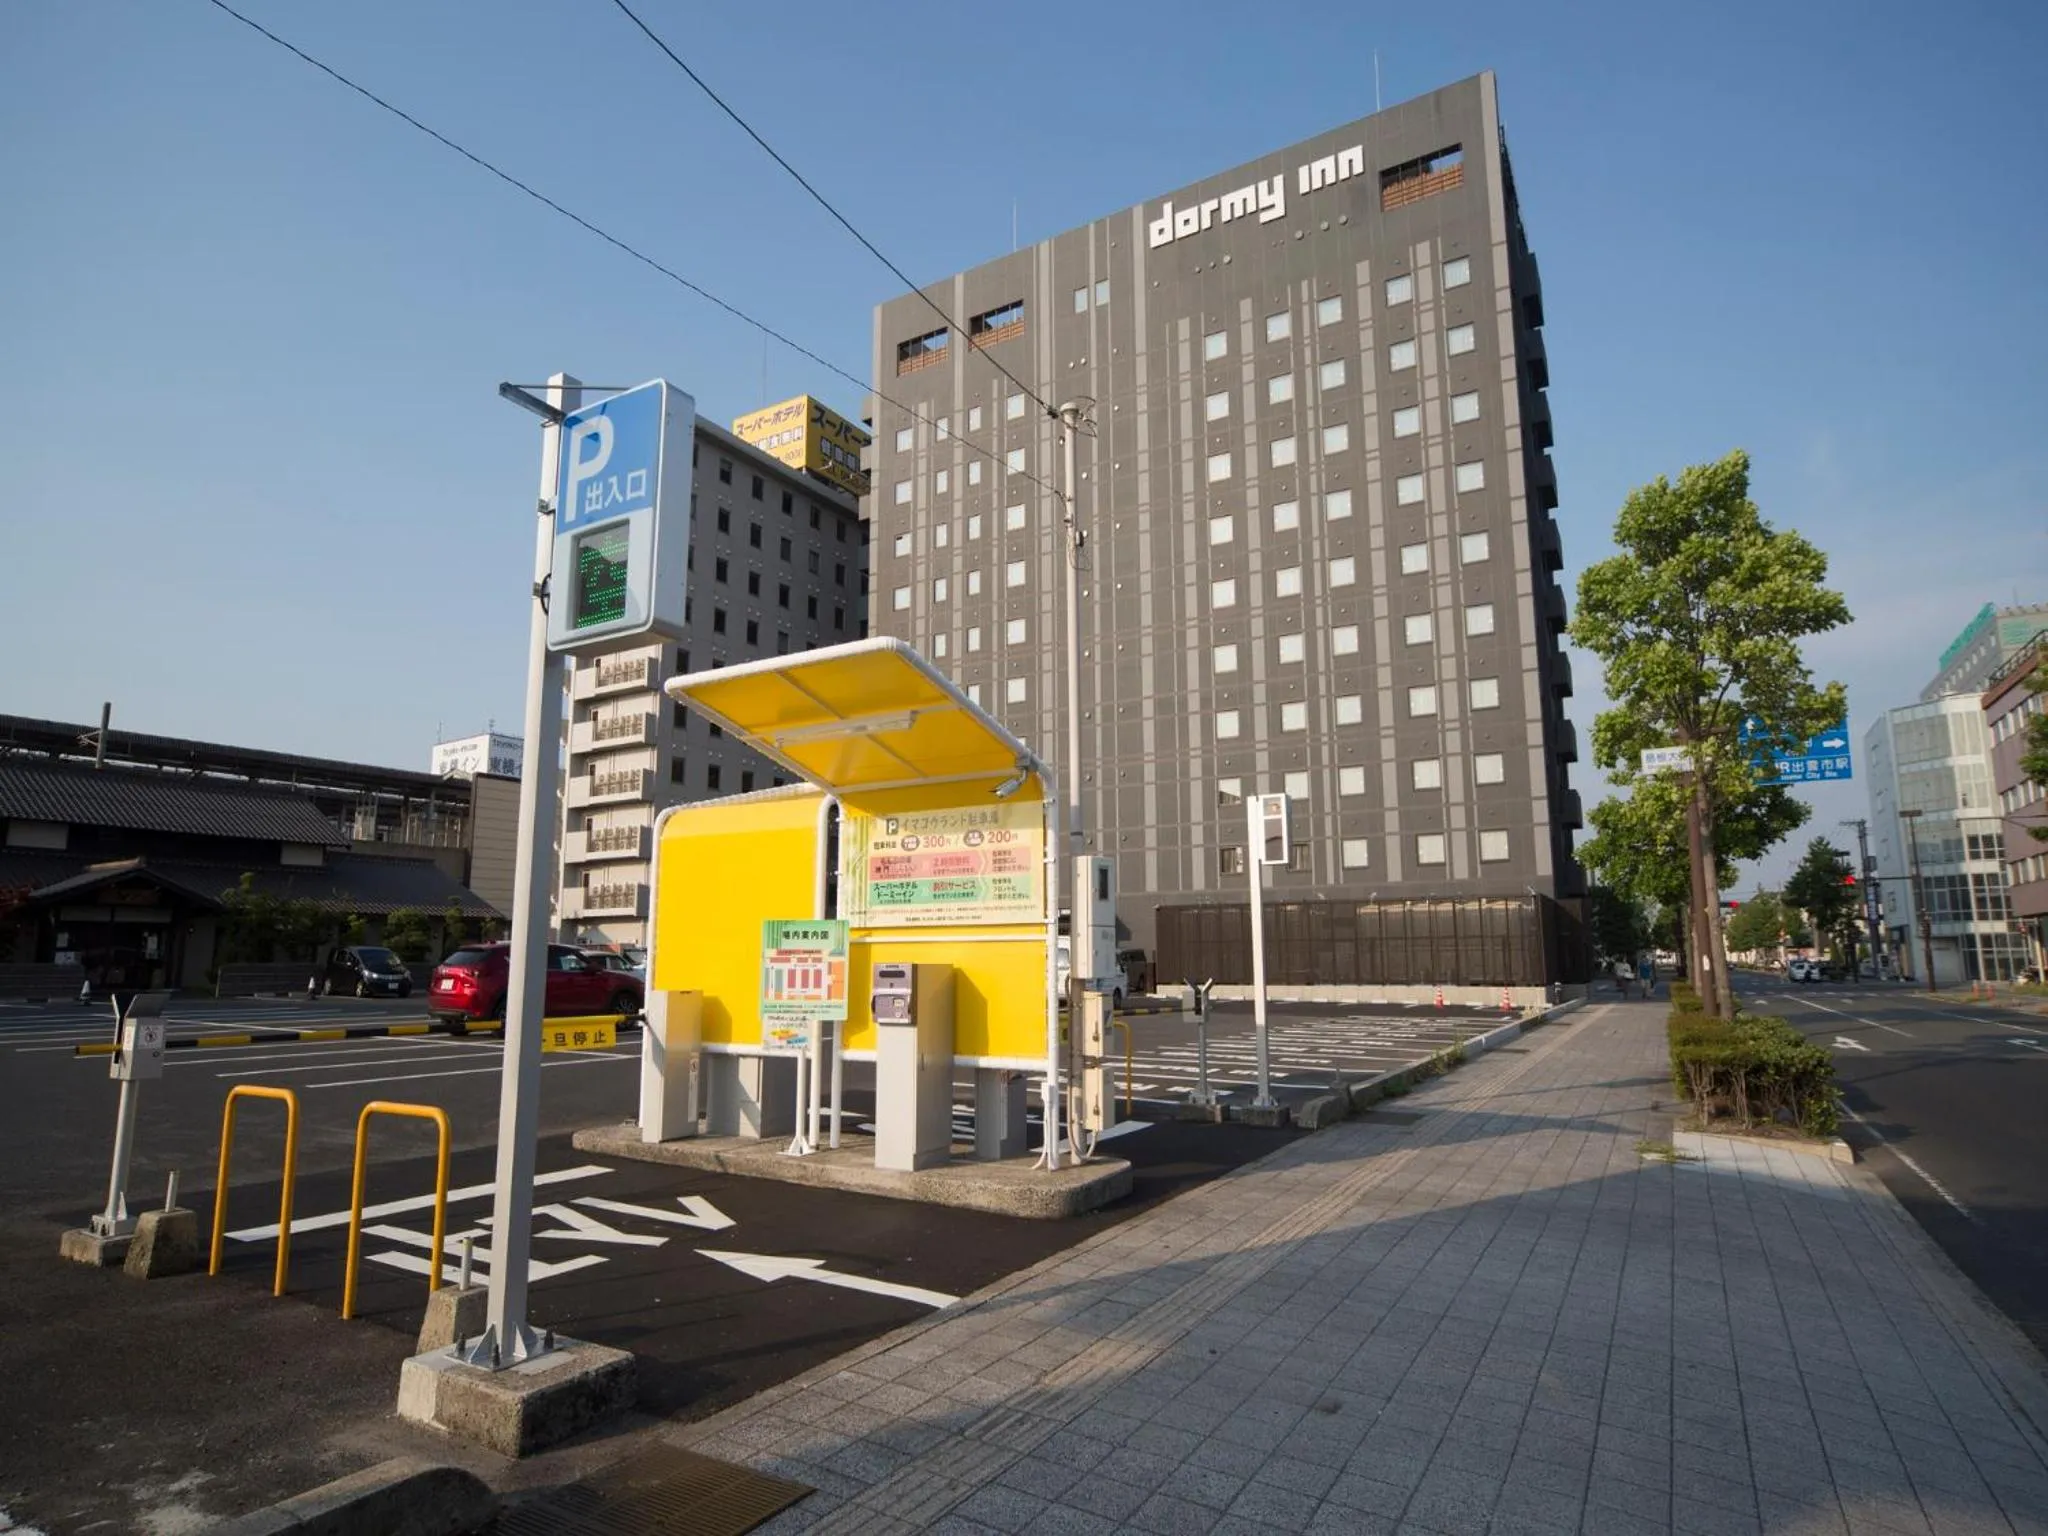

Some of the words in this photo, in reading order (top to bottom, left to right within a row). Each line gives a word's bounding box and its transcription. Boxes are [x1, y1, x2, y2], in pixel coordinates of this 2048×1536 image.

[1149, 174, 1286, 249] dormy
[1299, 144, 1365, 196] inn
[736, 402, 806, 437] スーパーホテル
[564, 414, 614, 523] P
[584, 468, 647, 514] 出入口
[886, 817, 899, 835] P
[873, 881, 918, 891] スーパーホテル
[542, 1029, 607, 1047] 旦停止
